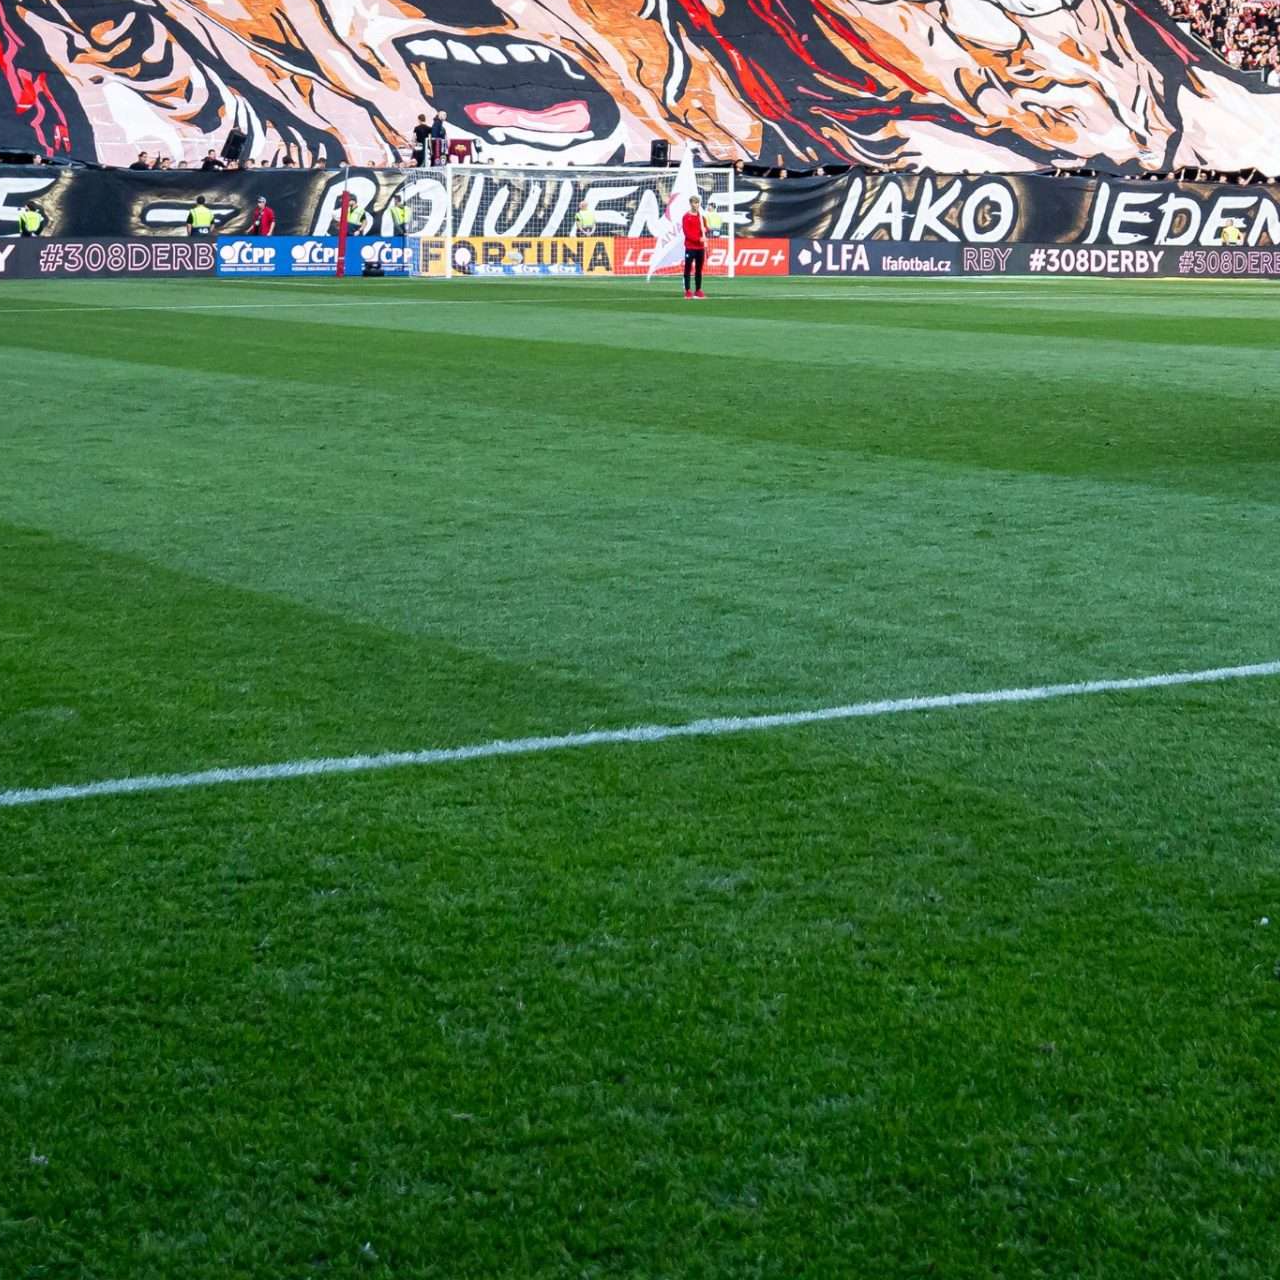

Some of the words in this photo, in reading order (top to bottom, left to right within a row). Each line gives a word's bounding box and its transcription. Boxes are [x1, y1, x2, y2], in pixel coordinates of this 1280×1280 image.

[39, 243, 217, 272] #308DERB
[240, 243, 276, 264] ČPP
[826, 243, 870, 271] LFA
[882, 255, 951, 271] lfafotbal.cz
[1029, 248, 1165, 274] #308DERBY
